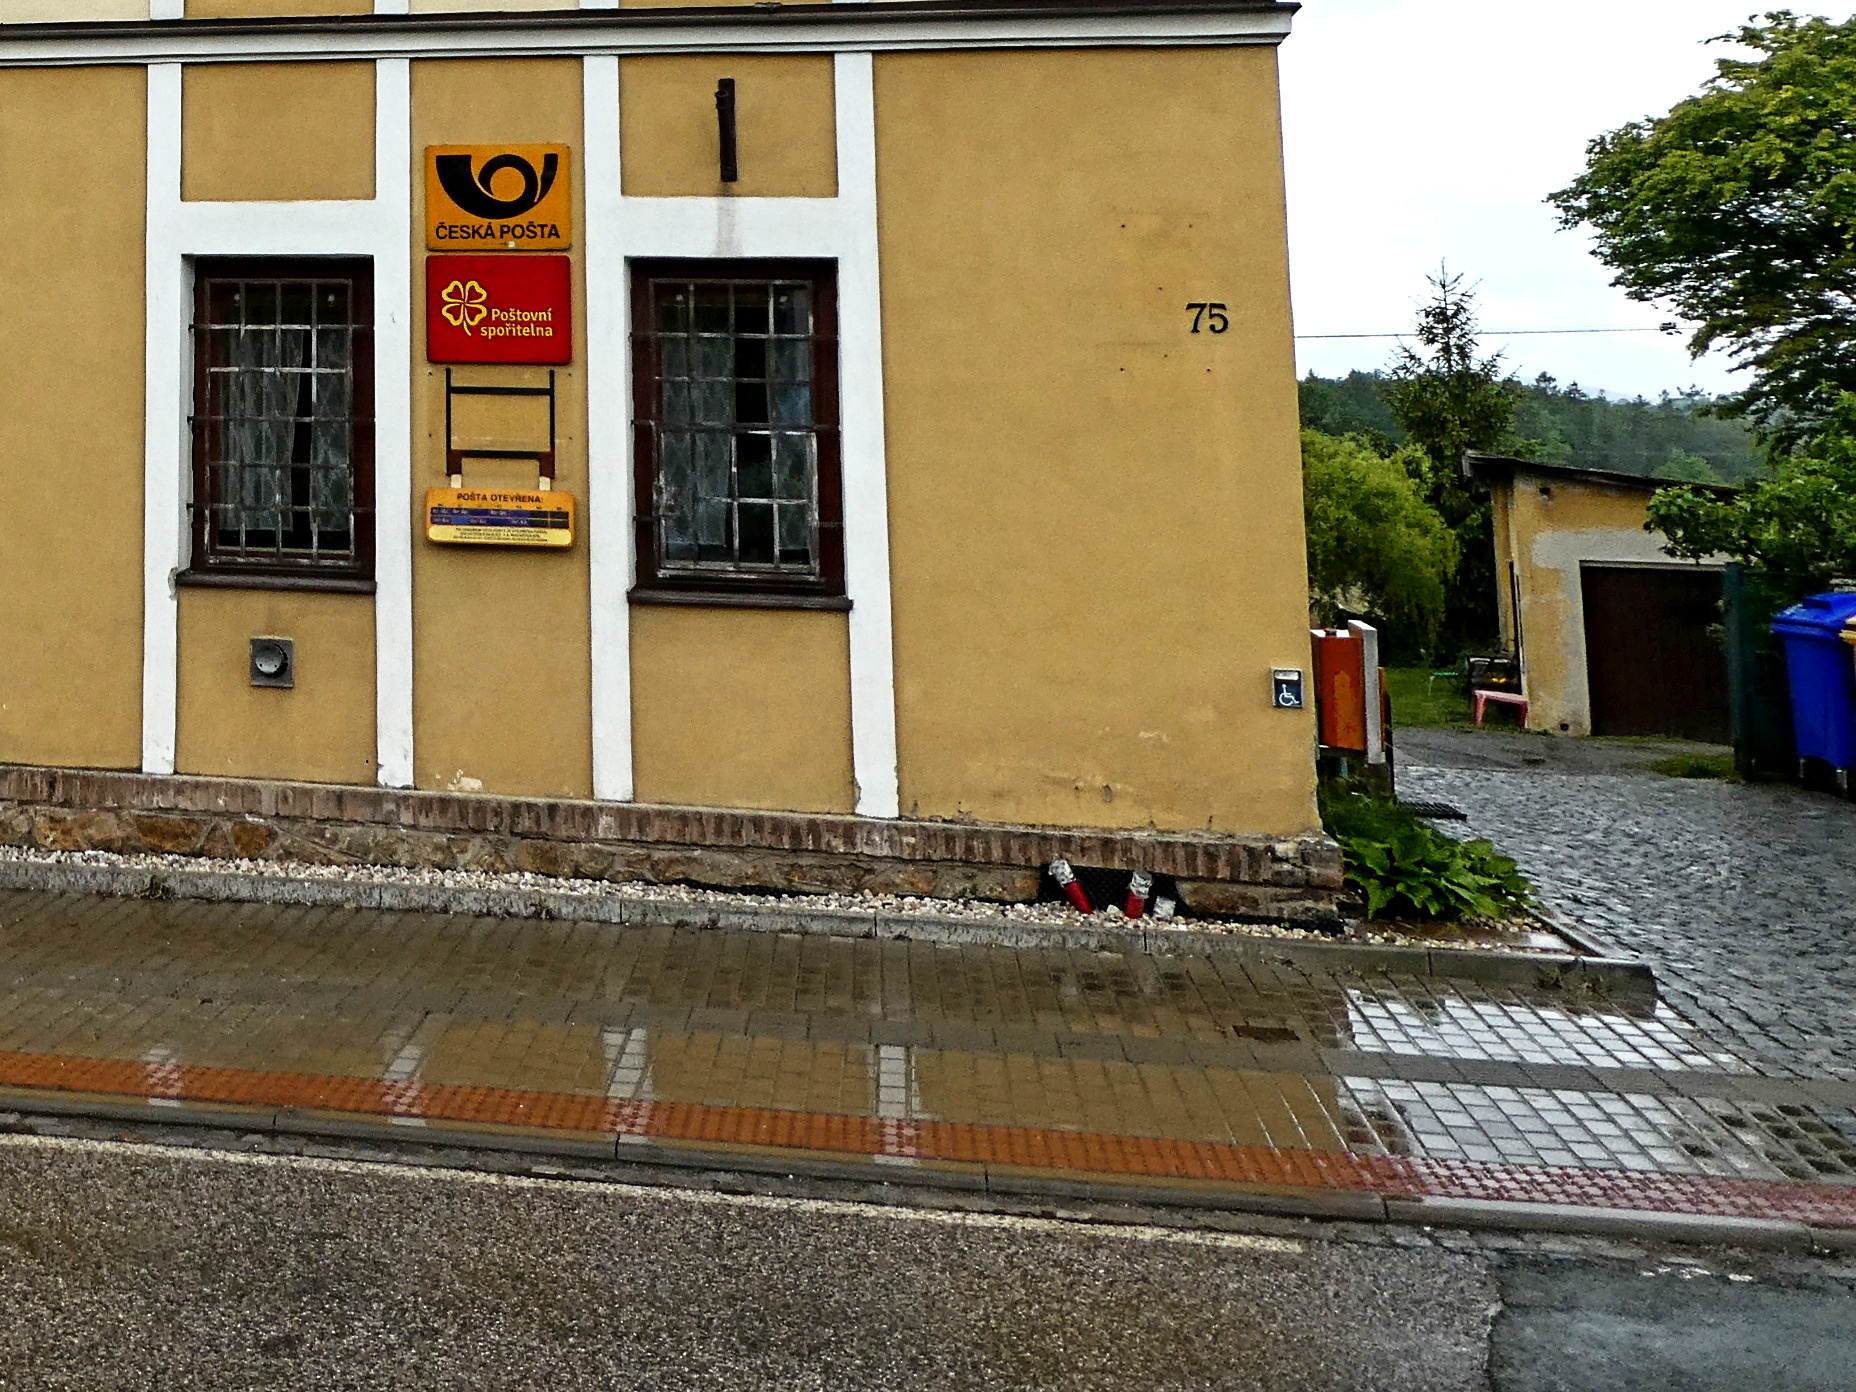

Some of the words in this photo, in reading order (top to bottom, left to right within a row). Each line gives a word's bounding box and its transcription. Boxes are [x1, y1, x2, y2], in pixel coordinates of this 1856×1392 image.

[435, 221, 496, 240] ČESKÁ
[499, 220, 561, 240] POŠTA
[491, 307, 552, 322] Poštovní
[1185, 302, 1229, 334] 75
[480, 322, 553, 340] spořitelna
[456, 491, 488, 502] POŠTA
